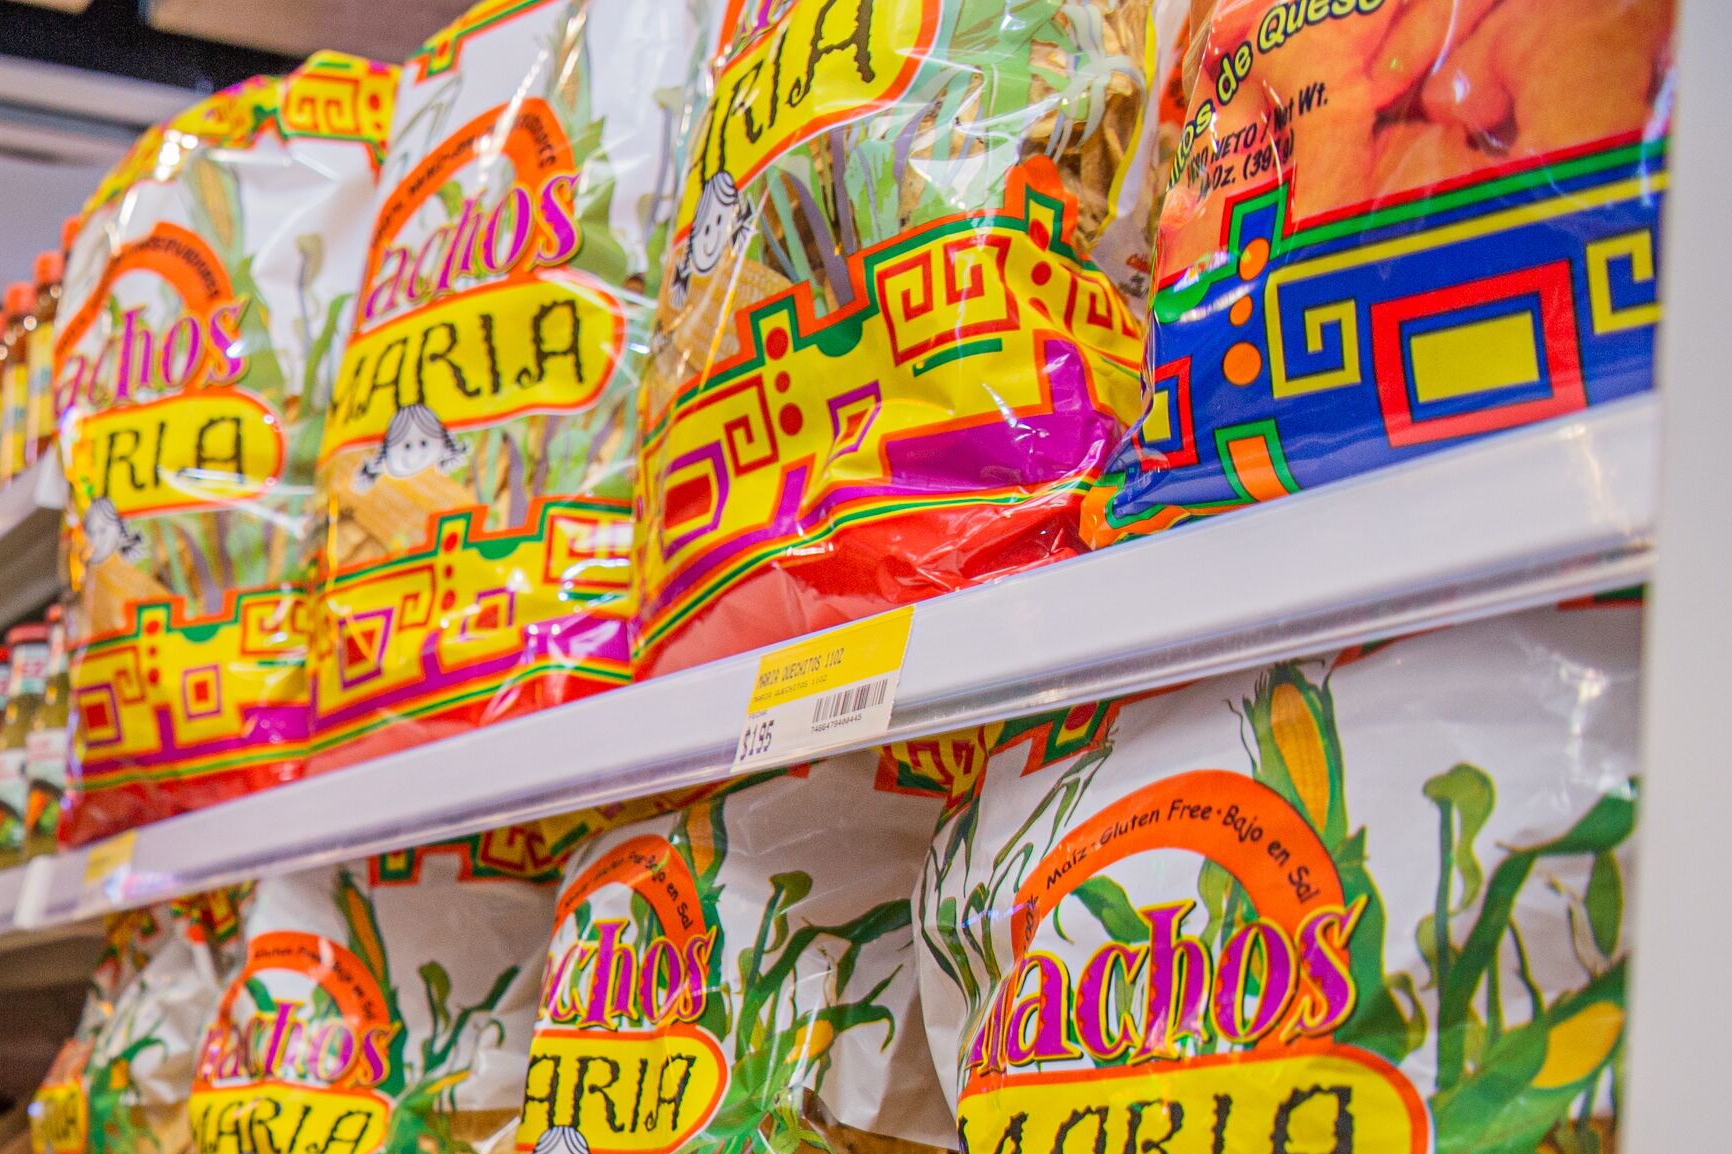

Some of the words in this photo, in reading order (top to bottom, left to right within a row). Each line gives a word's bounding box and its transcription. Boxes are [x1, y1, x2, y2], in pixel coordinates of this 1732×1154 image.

[702, 0, 876, 182] RIA
[1216, 40, 1254, 106] de
[1299, 82, 1329, 117] Wt.
[364, 170, 584, 320] achos
[53, 297, 250, 418] achos
[101, 415, 247, 502] RIA
[1099, 808, 1160, 846] Gluten
[1167, 799, 1213, 821] Free
[1222, 804, 1264, 843] Bajo
[1267, 839, 1290, 867] en
[1288, 865, 1322, 905] Sal
[676, 902, 694, 930] Sal
[536, 917, 717, 1031] chos
[521, 1054, 697, 1134] ARIA
